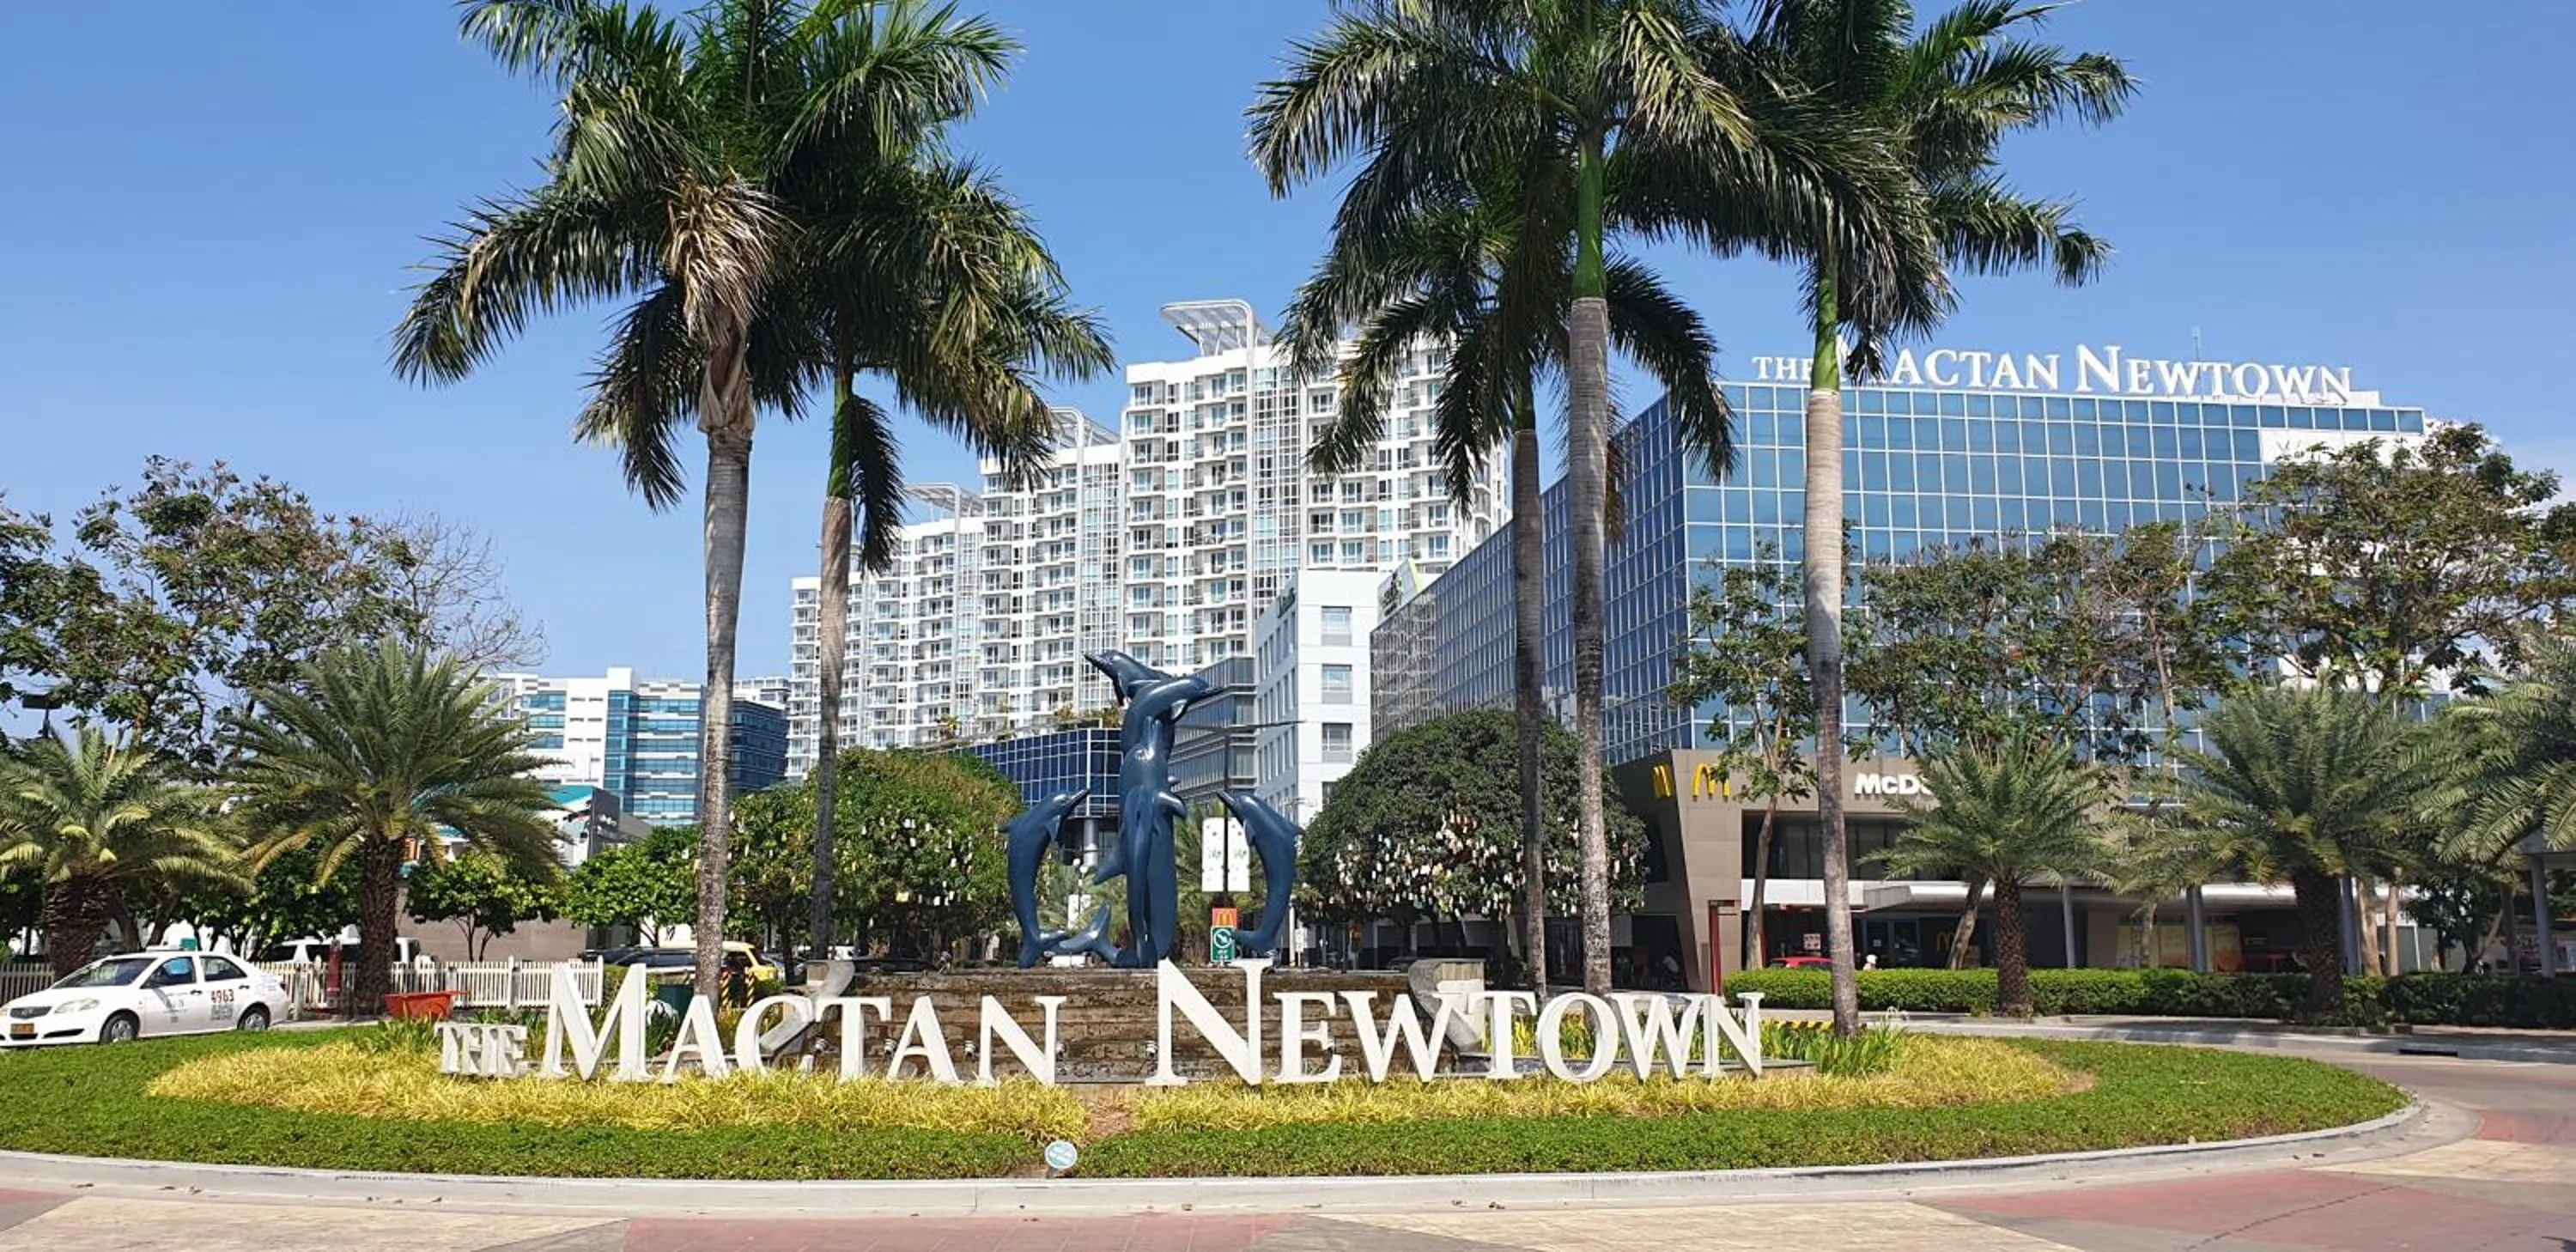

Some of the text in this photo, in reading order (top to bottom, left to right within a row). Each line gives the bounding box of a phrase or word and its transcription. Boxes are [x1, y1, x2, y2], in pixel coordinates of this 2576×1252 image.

[1836, 341, 2060, 390] ACTAN
[2075, 343, 2351, 406] NEWTOWN
[434, 957, 1765, 1086] THE MACTAN NEWTOWN
